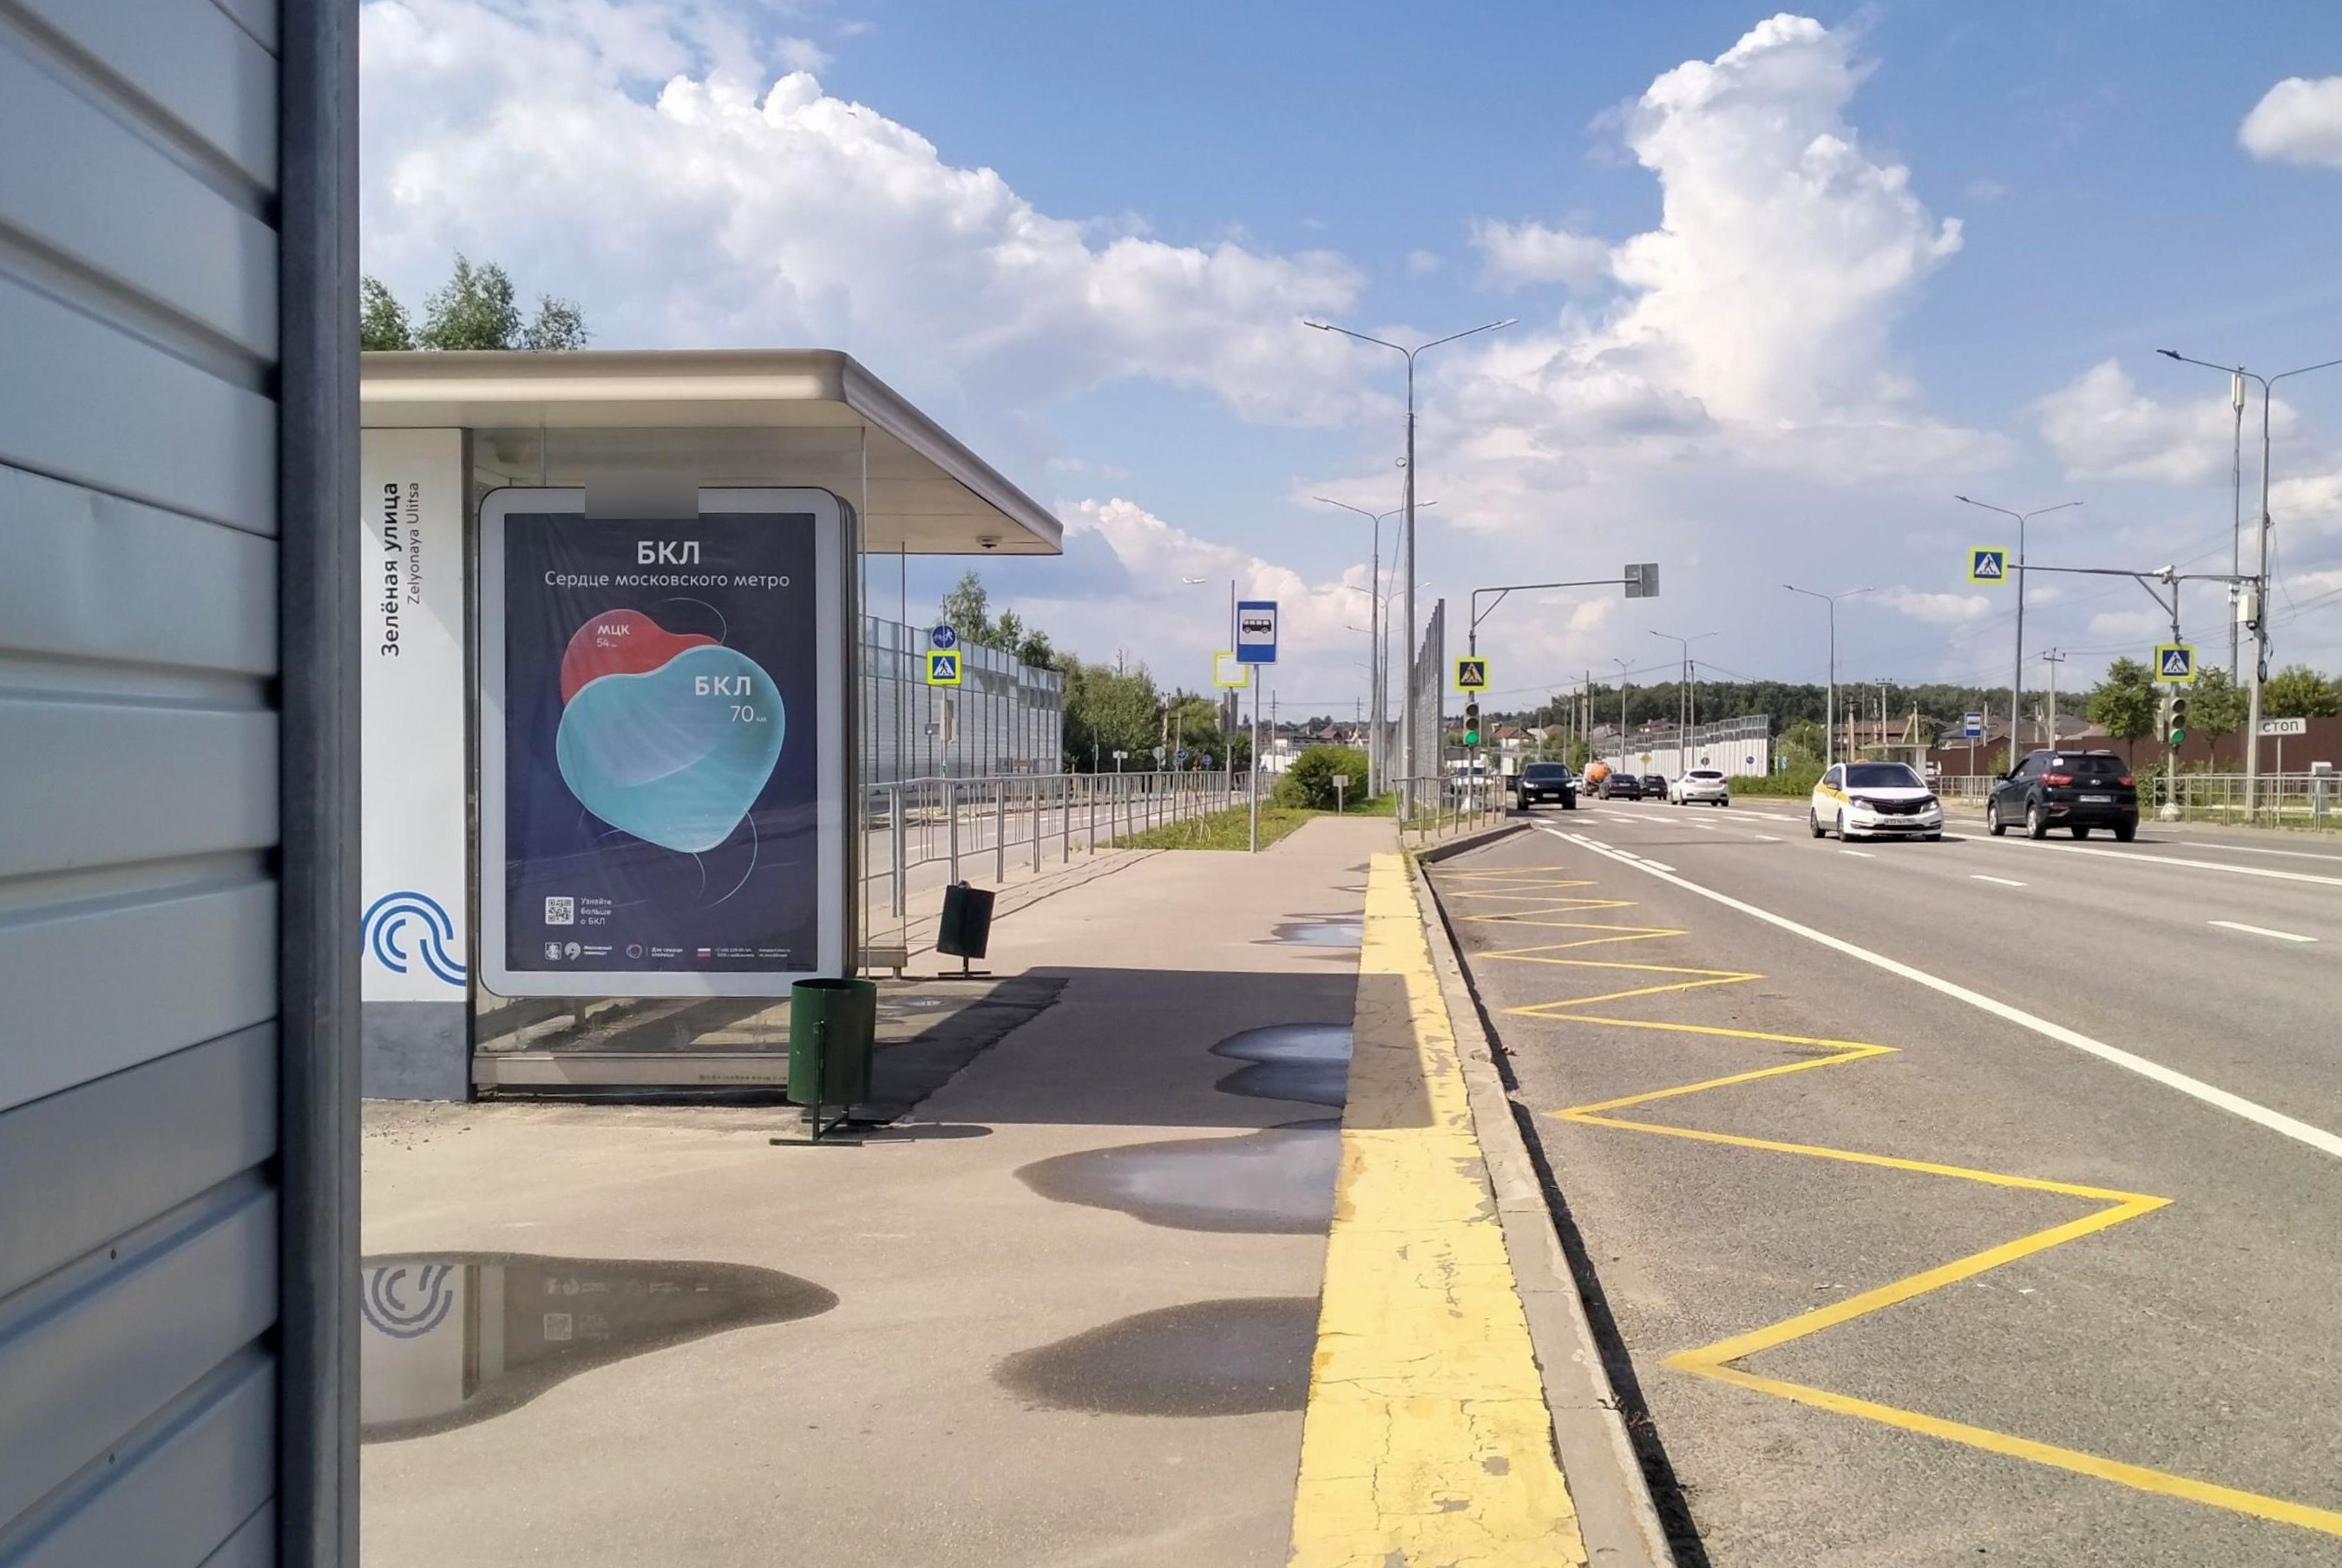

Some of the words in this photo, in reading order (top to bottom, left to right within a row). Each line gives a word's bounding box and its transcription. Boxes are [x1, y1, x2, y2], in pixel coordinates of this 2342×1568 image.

[405, 482, 419, 524] Ulitsa
[384, 482, 402, 553] улица
[637, 541, 699, 564] БКЛ
[407, 529, 423, 605] Zelyonaya
[544, 570, 609, 589] Сердце
[615, 573, 728, 587] московского
[733, 574, 791, 589] метро
[381, 561, 399, 657] Зелёная
[597, 625, 630, 636] МЦК
[596, 638, 609, 647] 54
[695, 675, 751, 696] БКЛ
[730, 705, 754, 722] 70
[2262, 721, 2299, 732] СТОП
[581, 896, 612, 905] Узнайте
[581, 907, 612, 915] больше
[588, 917, 606, 926] БКЛ
